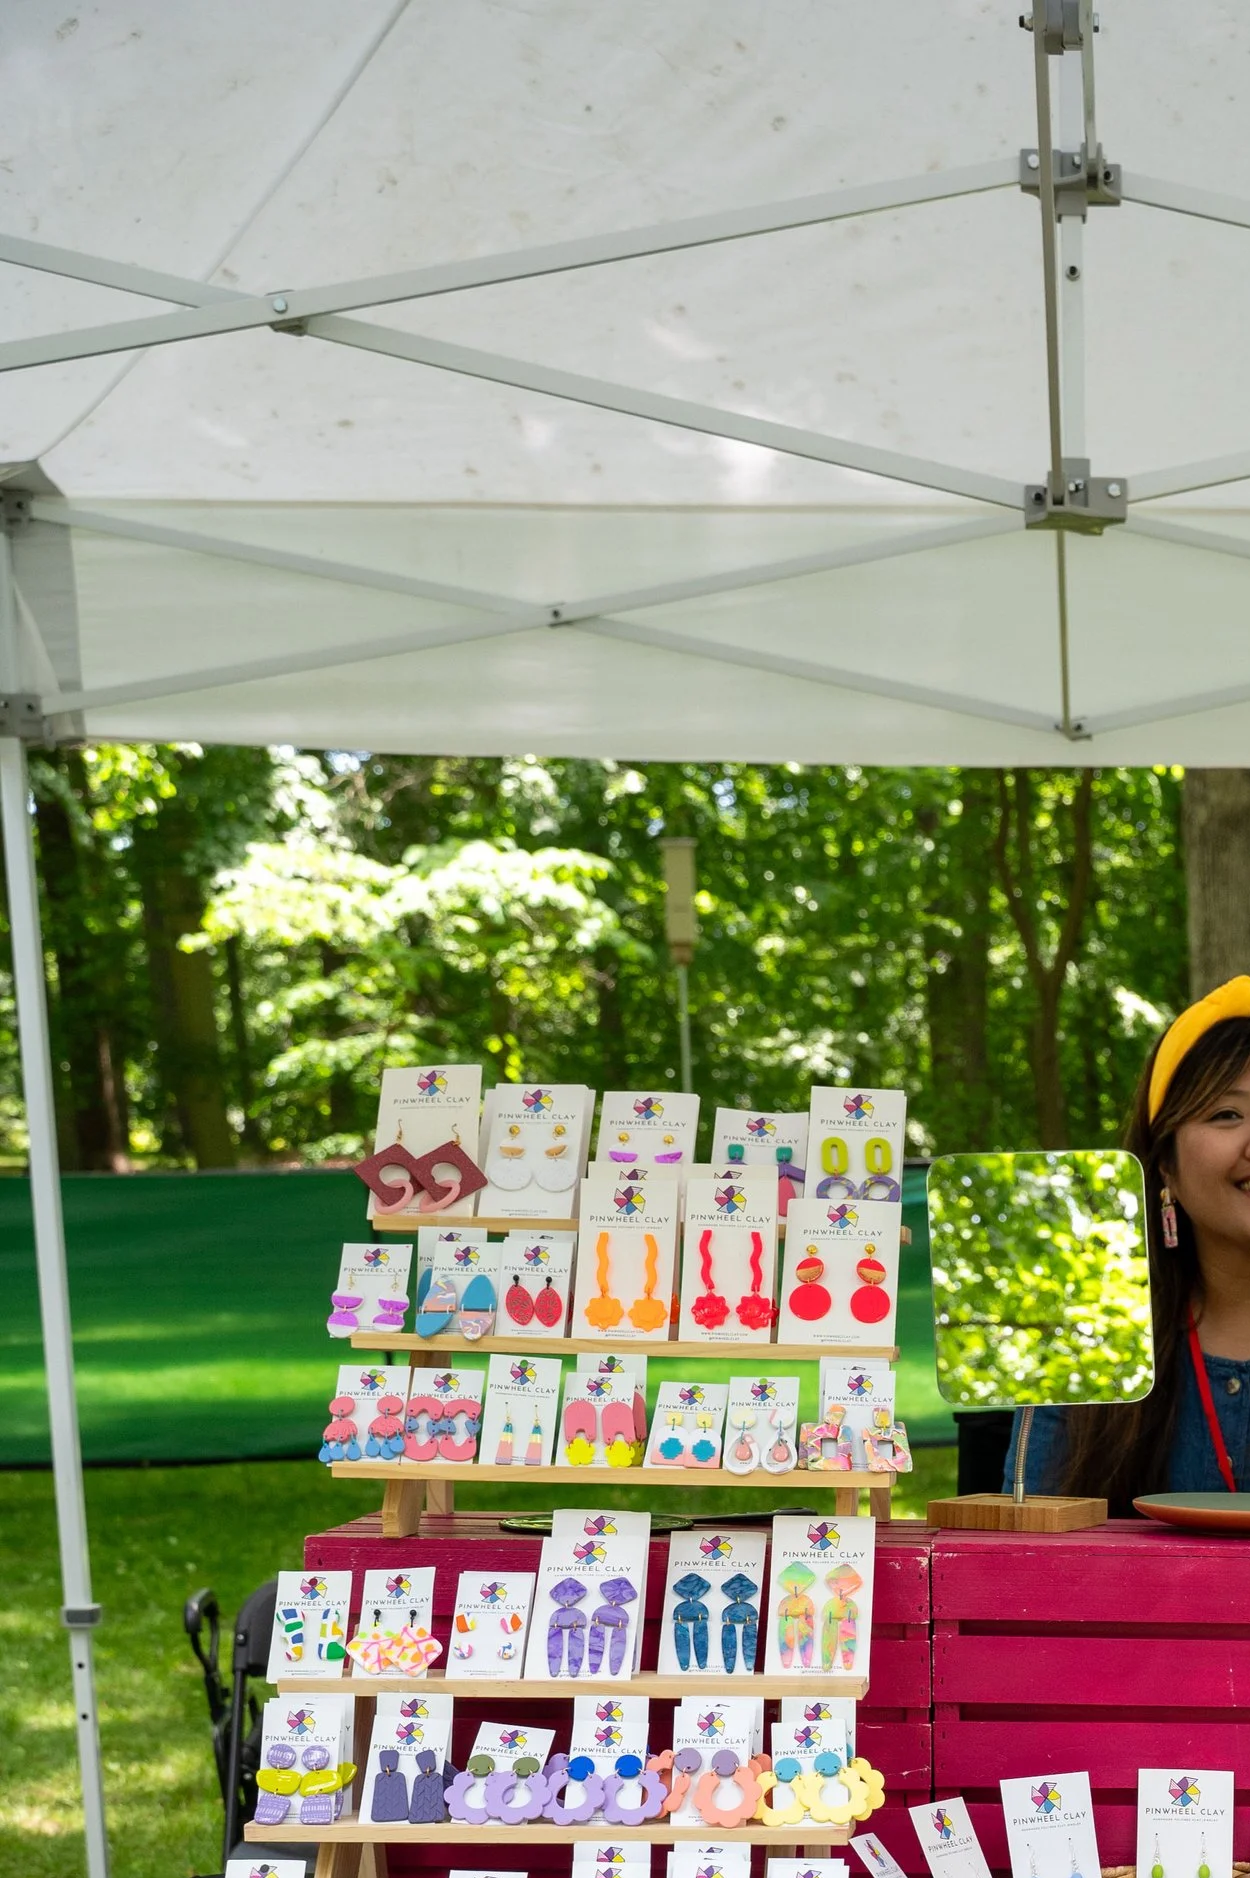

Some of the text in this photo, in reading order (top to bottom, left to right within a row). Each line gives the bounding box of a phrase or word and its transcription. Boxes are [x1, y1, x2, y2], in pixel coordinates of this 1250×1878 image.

[393, 1097, 442, 1105] PINWHEEL
[820, 1119, 869, 1127] PINWHEEL
[723, 1135, 771, 1144] PINWHEEL
[644, 1216, 669, 1224] CLAY
[690, 1214, 741, 1222] PINWHEEL
[489, 1384, 556, 1394] PINWHEEL CLAY
[827, 1395, 869, 1403] PINWHEEL
[658, 1403, 700, 1411] PINWHEEL
[782, 1551, 836, 1559] PINWHEEL
[674, 1560, 728, 1568] PINWHEEL
[676, 1737, 746, 1745] PINWHEEL CLAY
[476, 1745, 518, 1756] PINWHEEL
[573, 1747, 643, 1755] PINWHEEL CLAY
[1145, 1807, 1225, 1816] PINWHEEL CLAY
[1013, 1811, 1087, 1826] PINWHEEL CLAY
[928, 1836, 973, 1852] PINWHEEL CLAY
